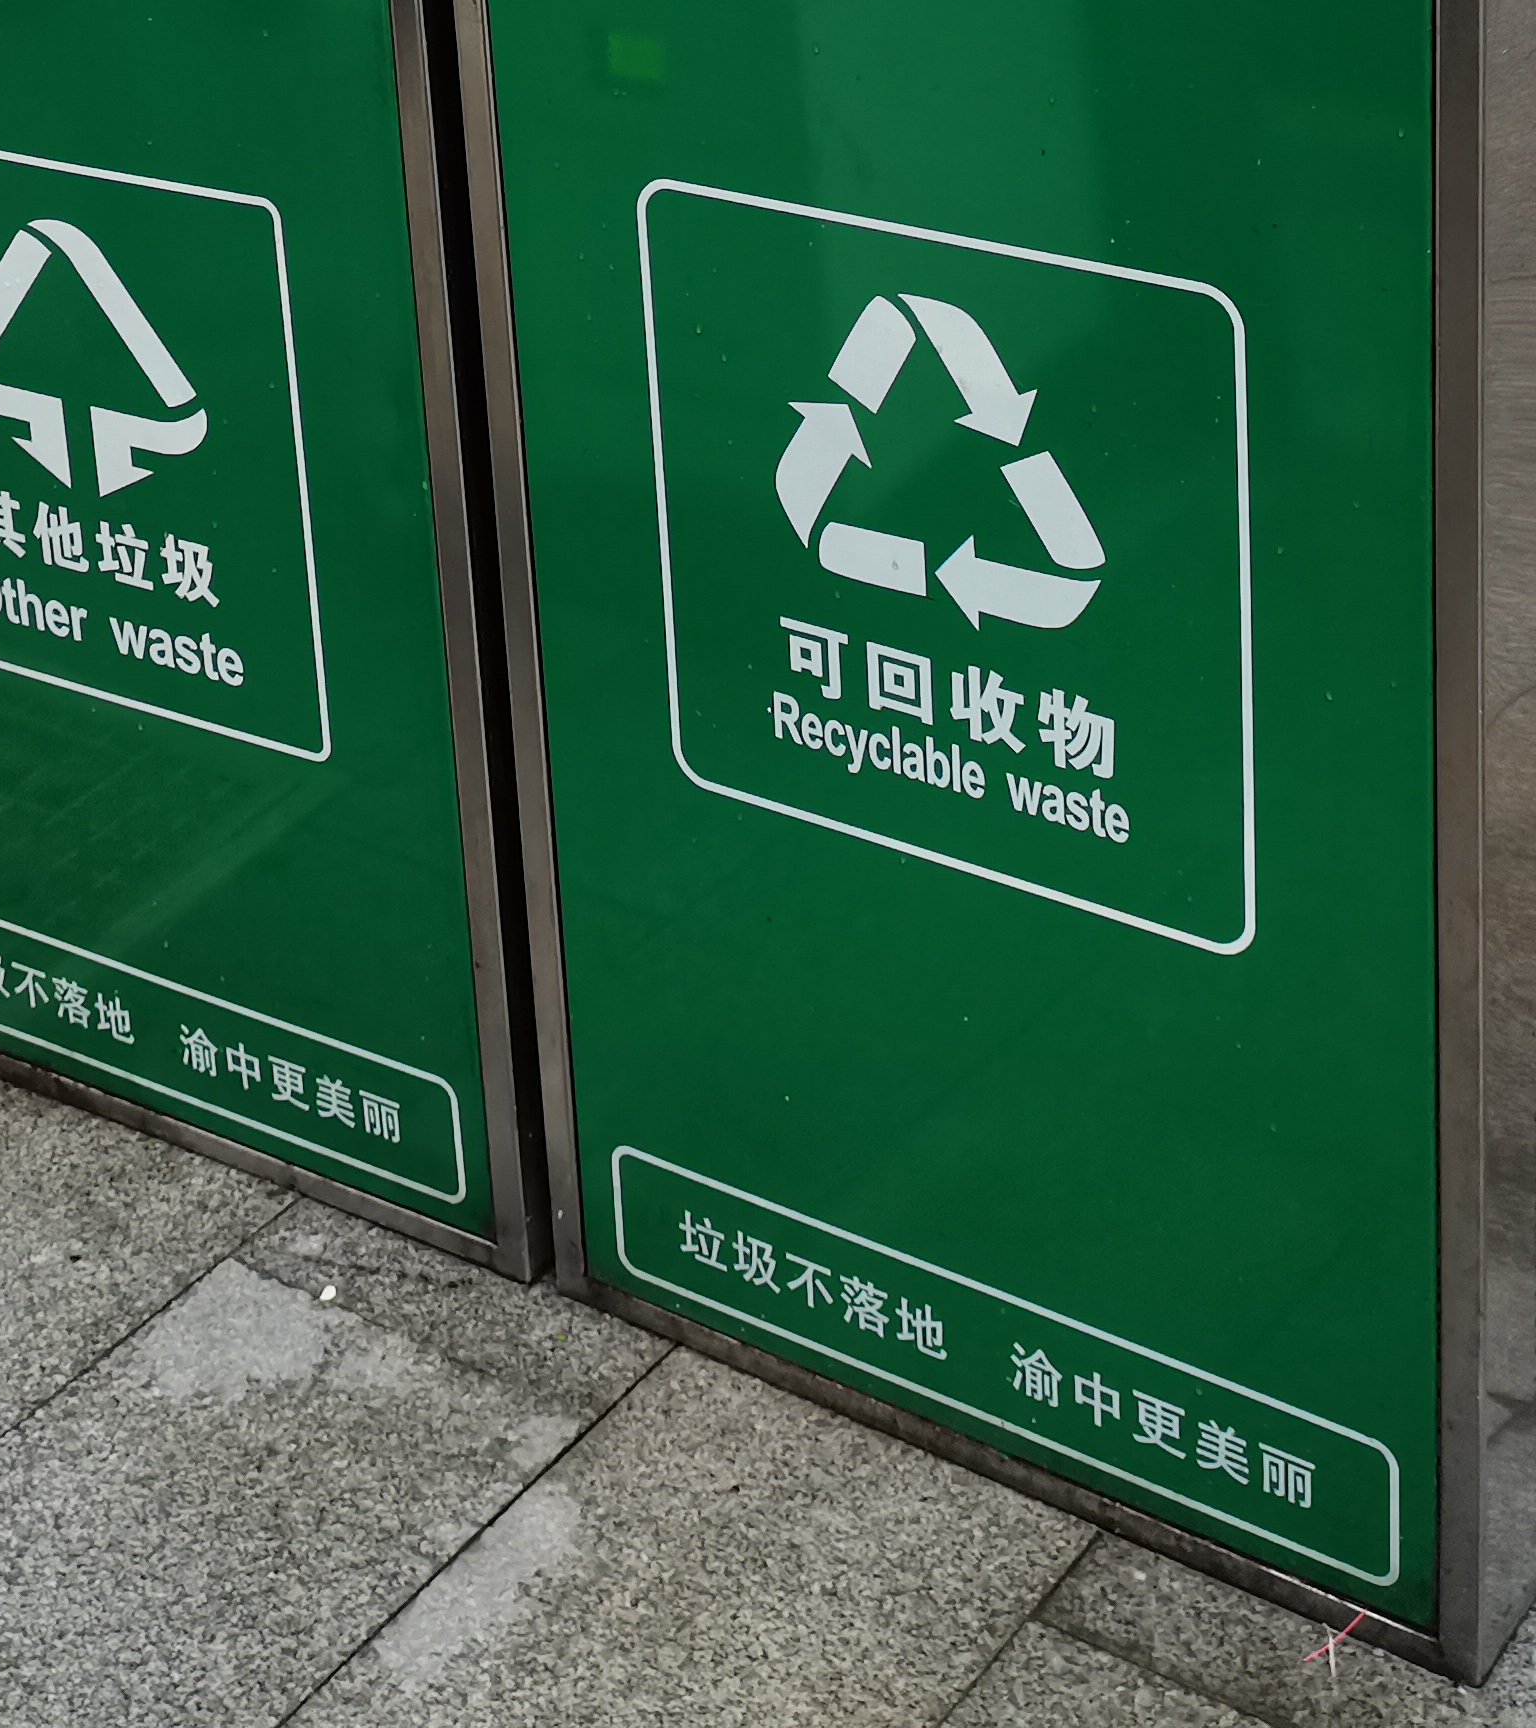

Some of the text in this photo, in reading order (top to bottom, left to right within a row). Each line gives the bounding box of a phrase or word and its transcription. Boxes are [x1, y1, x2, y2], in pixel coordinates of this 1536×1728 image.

[109, 616, 245, 687] waste
[779, 616, 1116, 780] 可回收物
[772, 690, 1131, 844] Recyclable waste
[179, 1022, 402, 1145] 渝中更美丽
[678, 1209, 1317, 1510] 垃圾不落地 渝中更美丽
